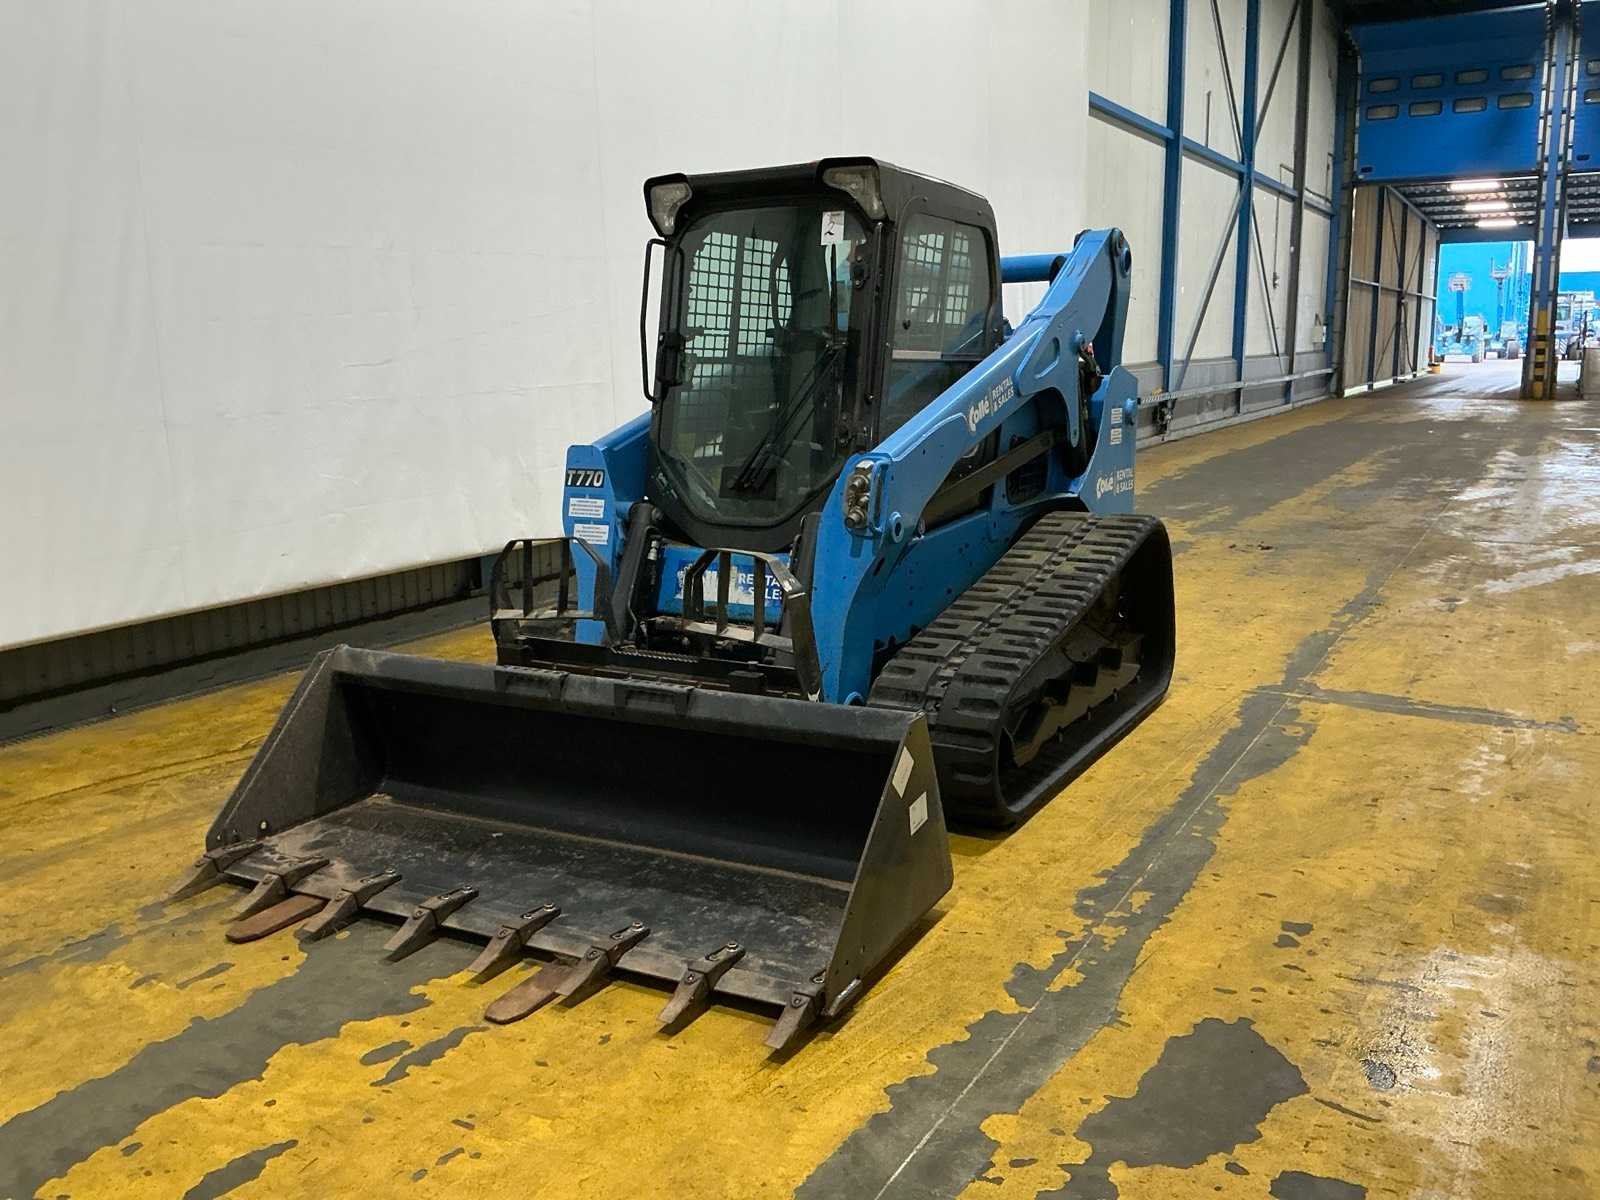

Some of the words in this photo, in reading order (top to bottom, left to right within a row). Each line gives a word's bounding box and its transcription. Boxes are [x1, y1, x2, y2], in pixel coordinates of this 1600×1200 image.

[992, 376, 1013, 400] RENTAL
[998, 386, 1015, 408] SALES
[567, 470, 603, 487] T770
[738, 573, 780, 587] RETA
